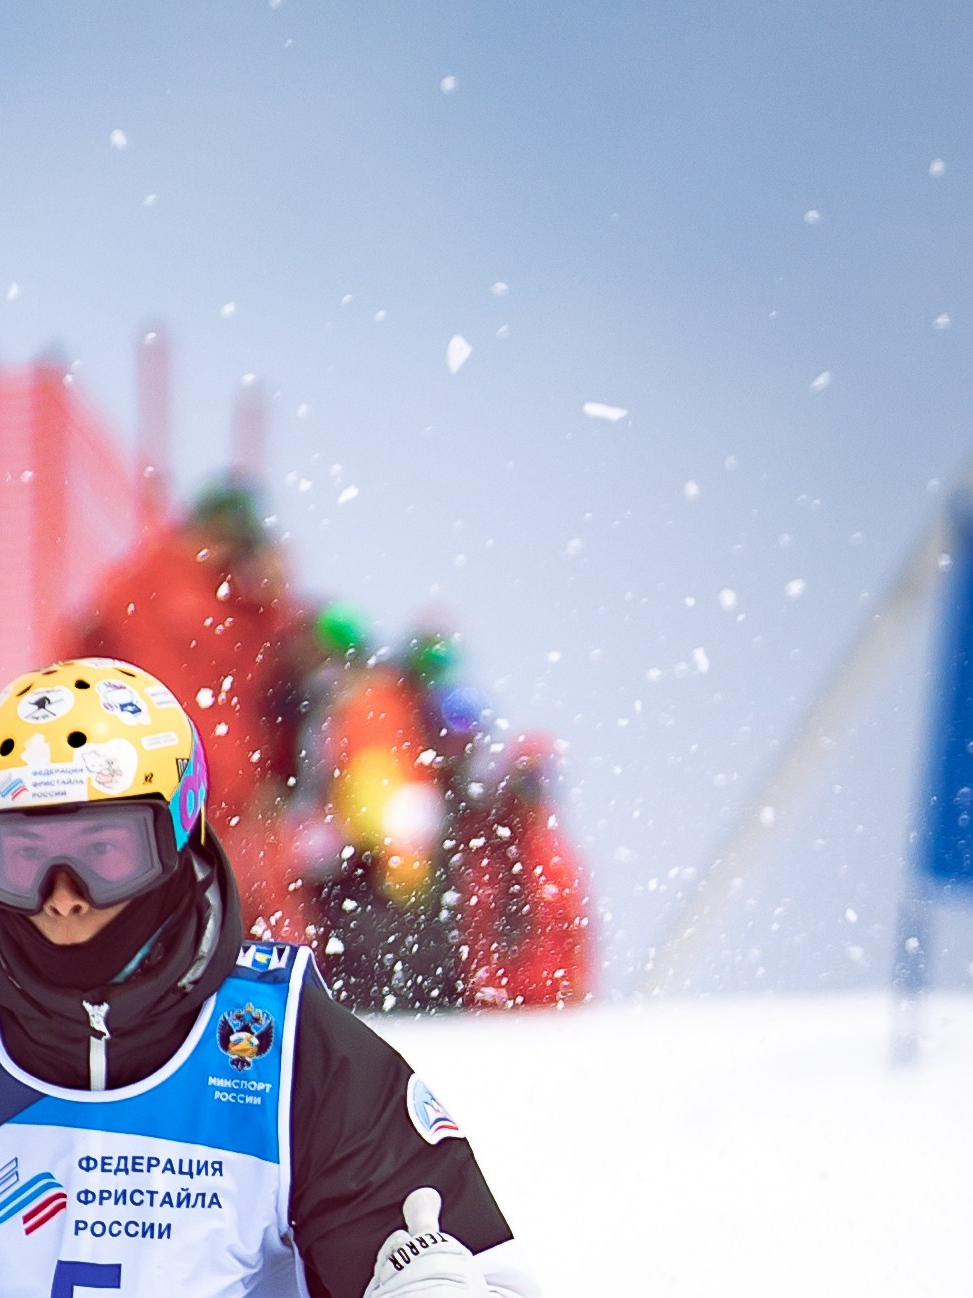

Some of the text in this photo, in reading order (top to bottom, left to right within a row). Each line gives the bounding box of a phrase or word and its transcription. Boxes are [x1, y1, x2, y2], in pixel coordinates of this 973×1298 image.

[32, 767, 84, 777] ФЕДЕРАЦИЯ
[31, 790, 67, 799] РОССИИ
[207, 1075, 273, 1093] МИНСПОРТ
[213, 1090, 262, 1105] РОССИИ
[77, 1155, 224, 1179] ФЕДЕРАЦИЯ
[76, 1187, 223, 1209] ФРИСТАЙЛА
[73, 1219, 172, 1240] РОССИИ
[388, 1232, 448, 1271] TERROR
